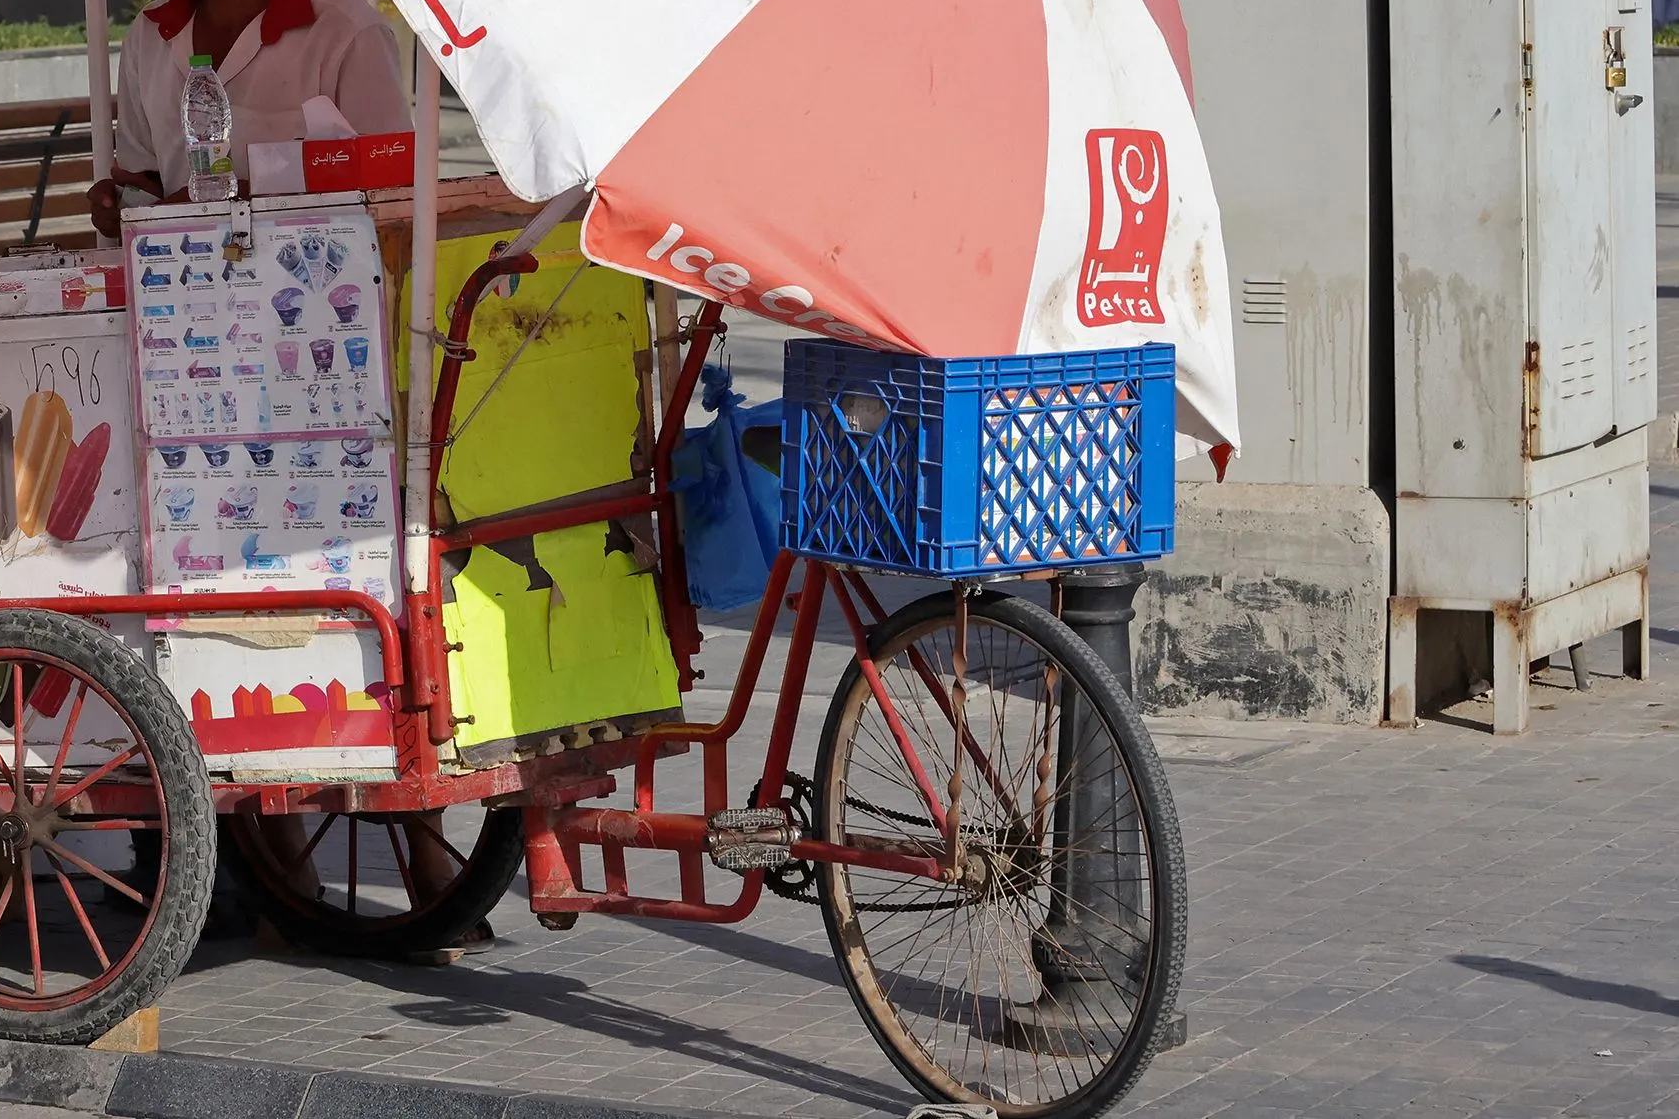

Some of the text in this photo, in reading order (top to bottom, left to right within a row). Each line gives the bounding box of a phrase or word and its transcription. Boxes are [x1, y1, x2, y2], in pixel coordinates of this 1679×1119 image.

[646, 222, 752, 294] Ice
[1086, 251, 1151, 293] بترا
[1083, 291, 1155, 320] Petra
[31, 342, 101, 408] 596
